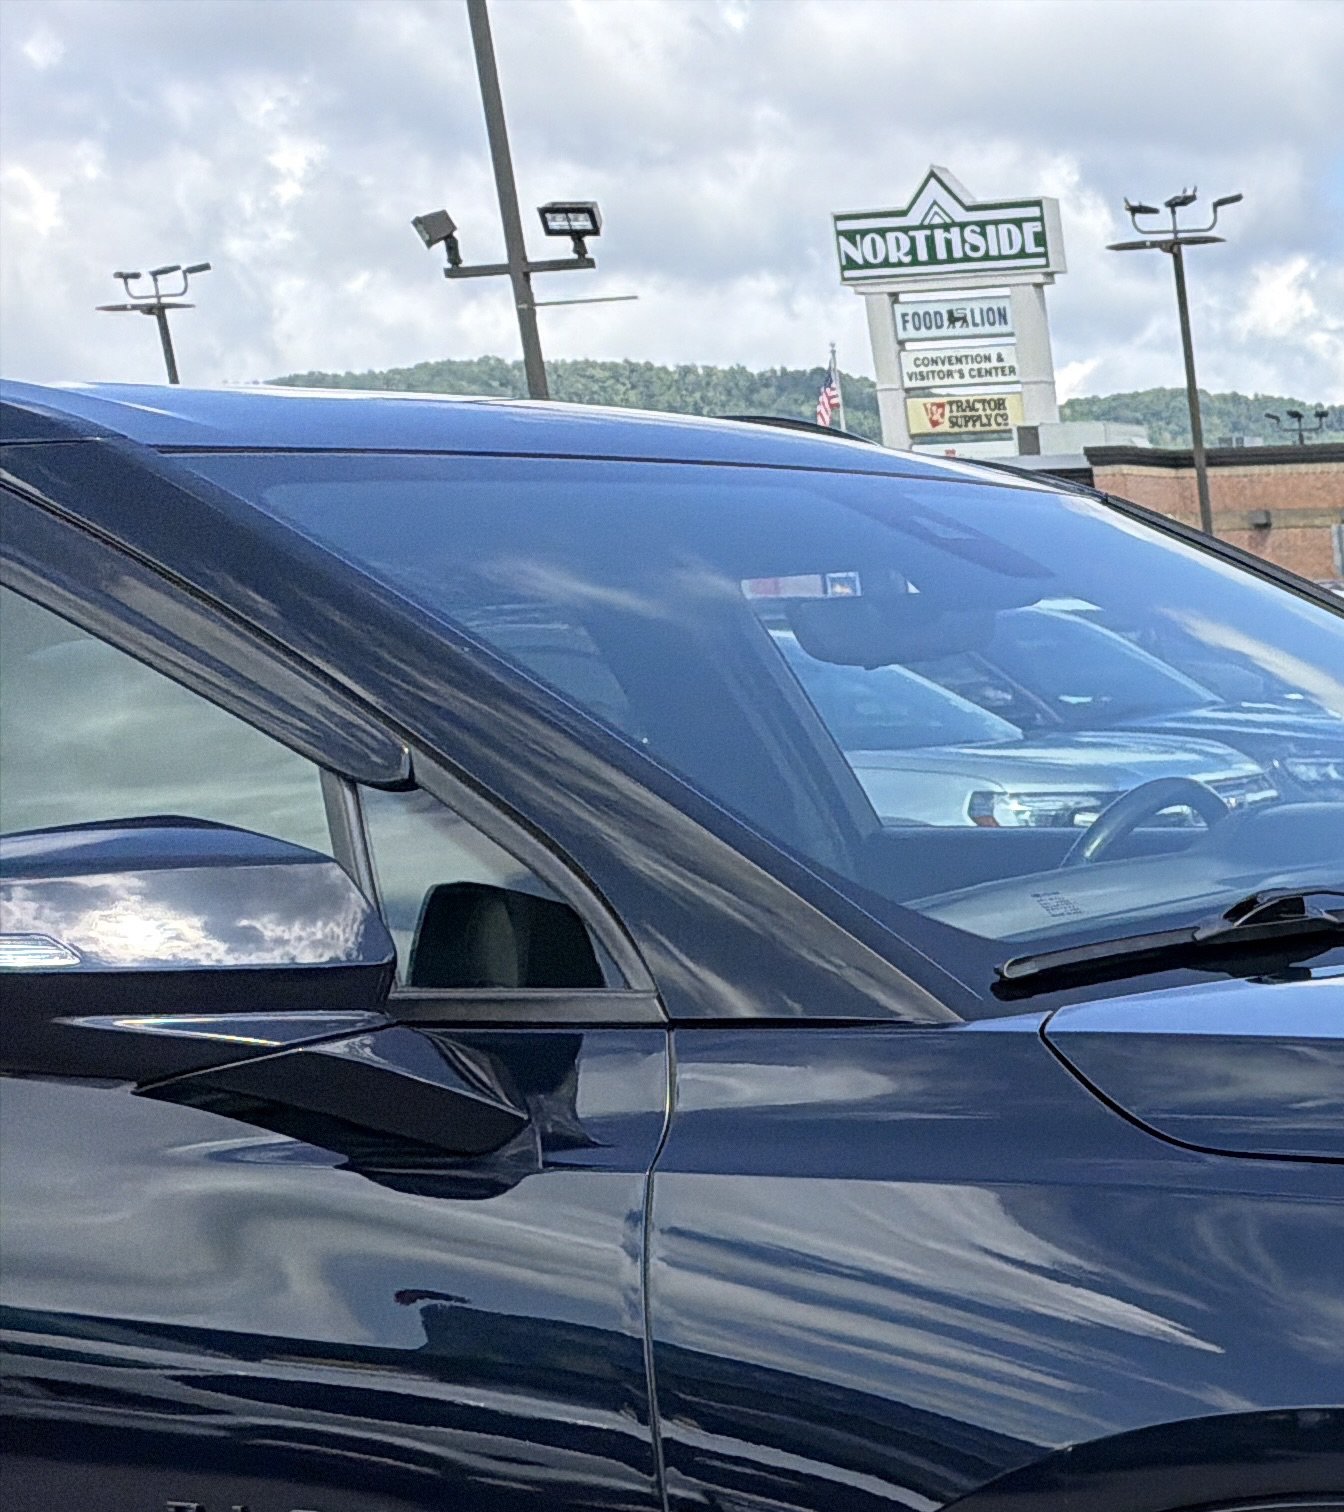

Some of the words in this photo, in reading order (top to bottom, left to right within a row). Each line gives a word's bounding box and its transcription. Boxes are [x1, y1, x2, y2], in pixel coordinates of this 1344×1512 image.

[838, 221, 1046, 266] NORTHSIDE
[901, 310, 944, 332] FOOD
[970, 306, 1009, 328] LION
[913, 353, 992, 368] CONVENTION
[996, 352, 1005, 363] &
[906, 368, 965, 382] VISITOR'S
[968, 365, 1017, 379] CENTER
[947, 398, 1007, 413] TRACTOR
[948, 413, 992, 428] SUPPLY
